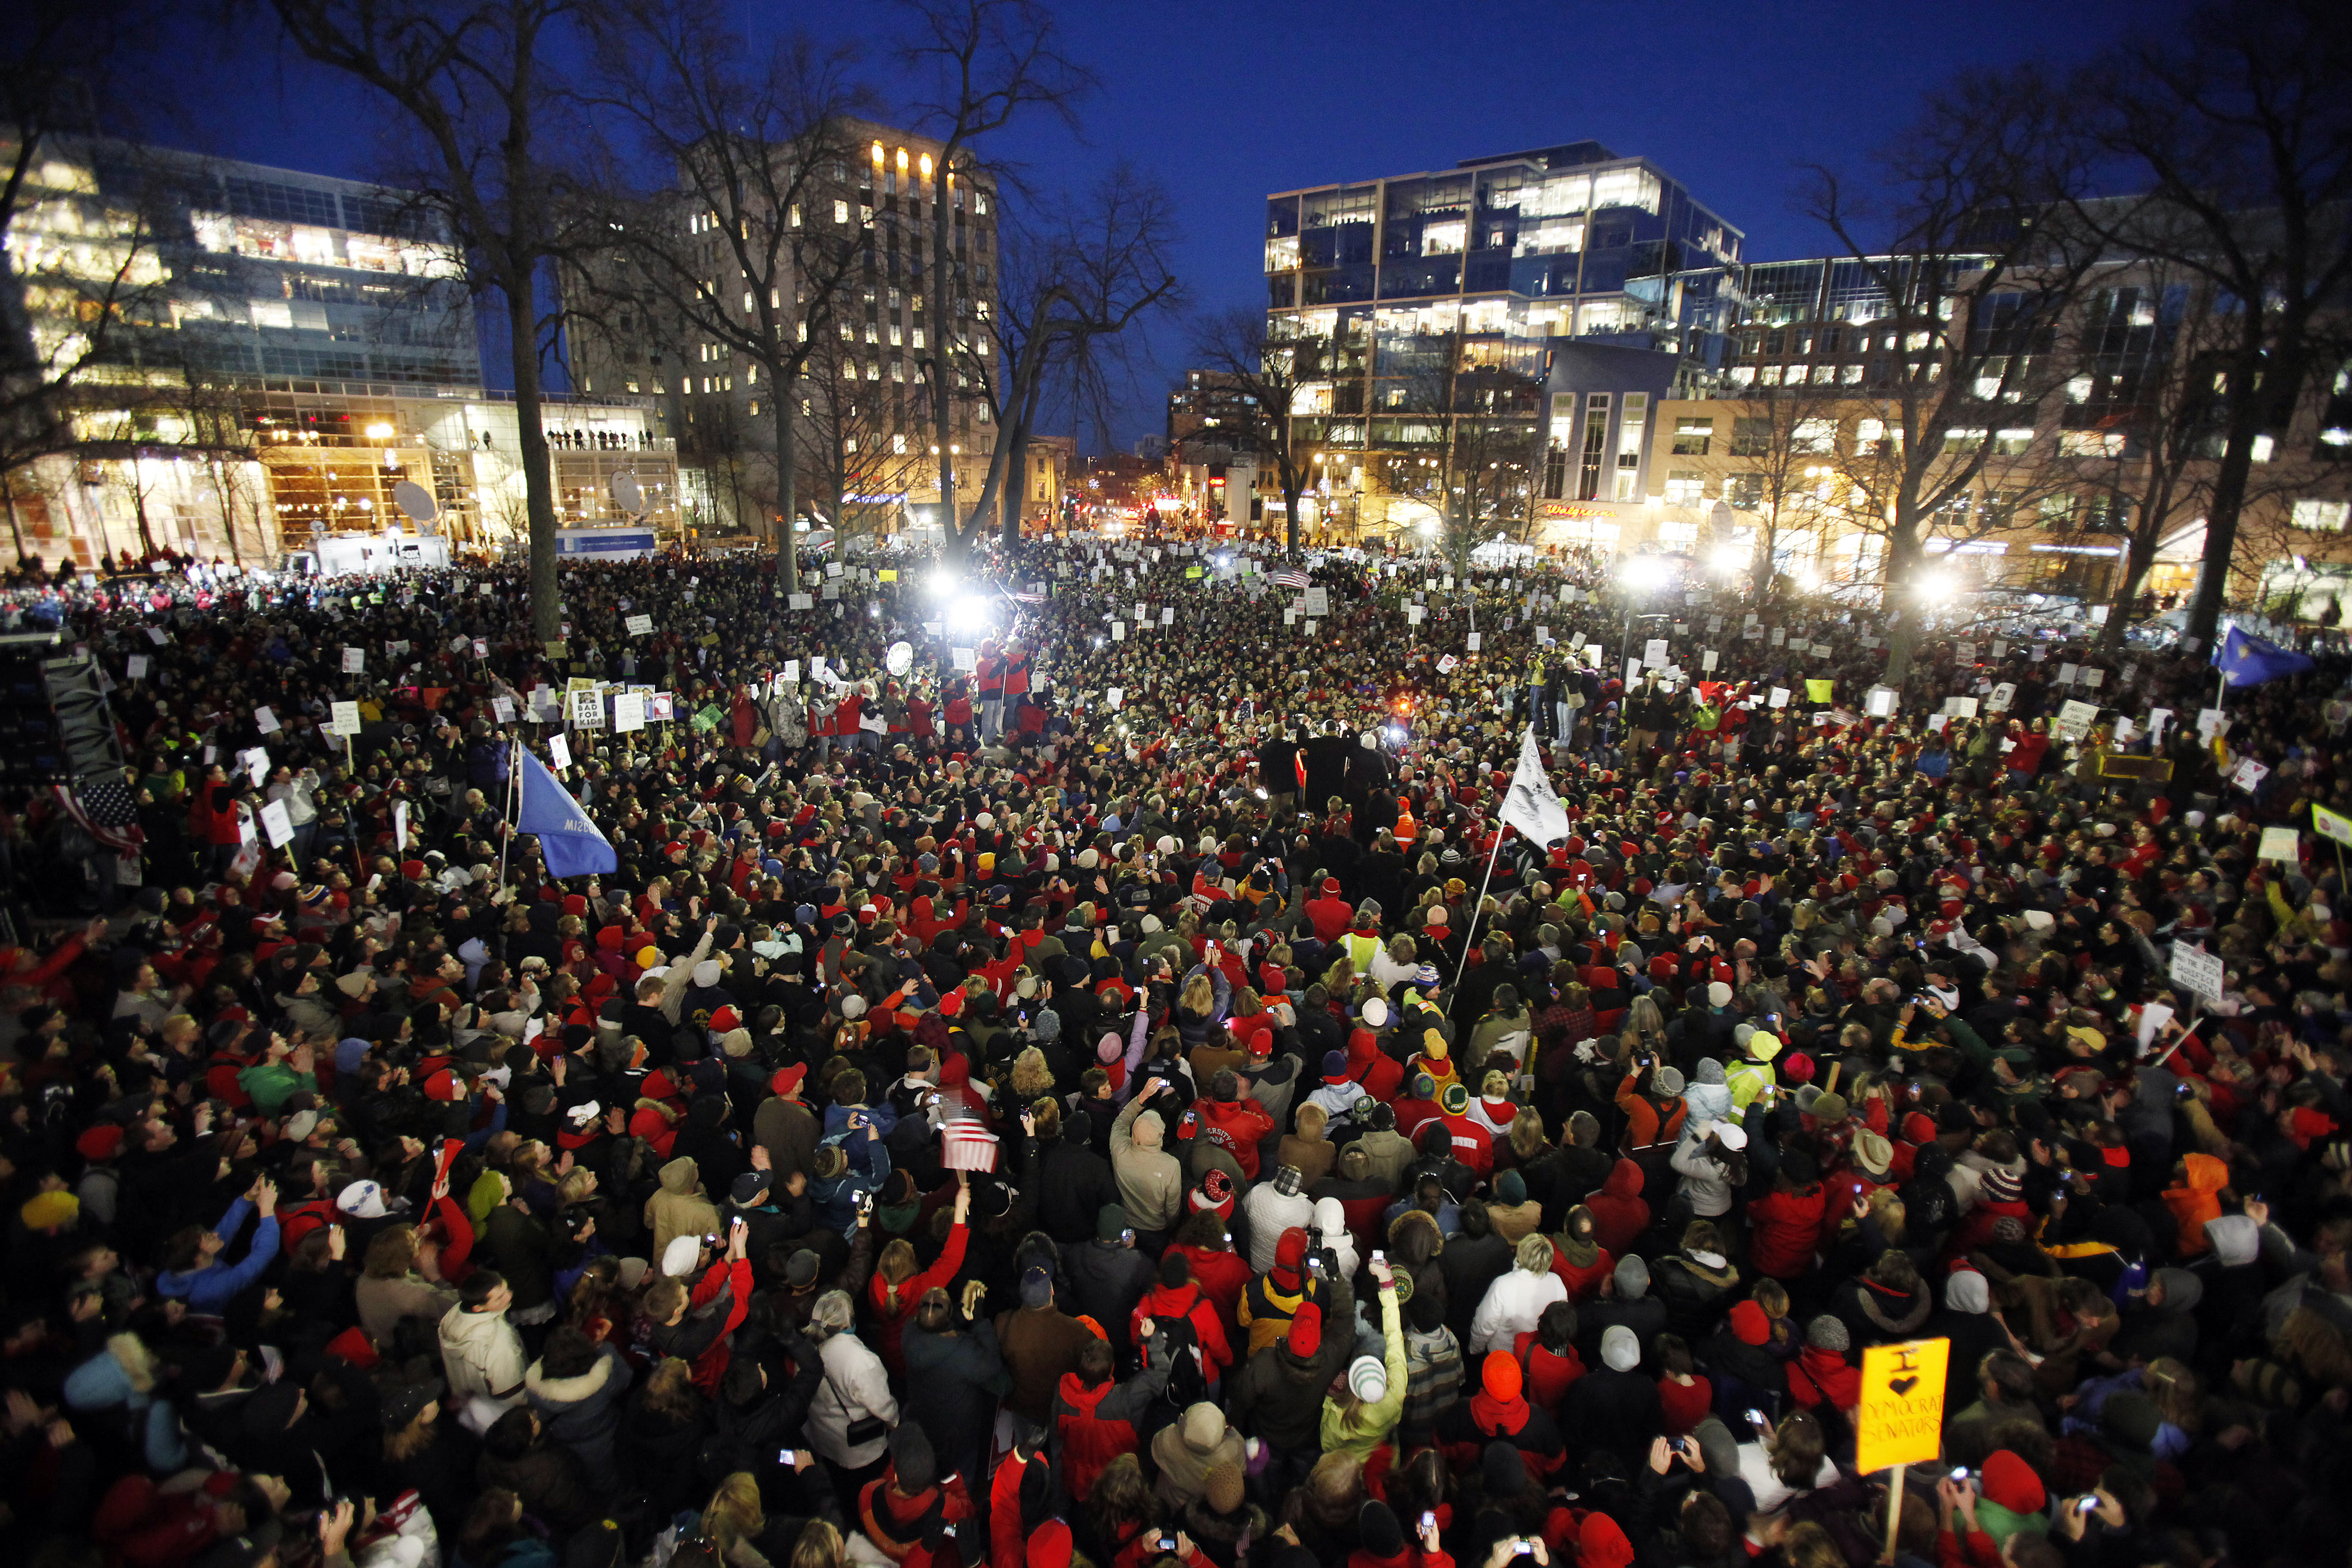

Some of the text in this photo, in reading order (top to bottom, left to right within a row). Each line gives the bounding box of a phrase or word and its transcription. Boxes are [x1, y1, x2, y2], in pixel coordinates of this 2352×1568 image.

[1265, 502, 1287, 511] PARK
[1545, 504, 1618, 518] Walgreens
[400, 550, 420, 559] FOX
[893, 656, 913, 674] UNION
[2174, 952, 2221, 978] AND THE RICH
[2176, 962, 2215, 987] SACRIFICE
[2180, 974, 2219, 999] NOTHING
[1227, 1141, 1236, 1151] OF
[1889, 1346, 1920, 1373] I
[1860, 1415, 1942, 1447] SENATORS
